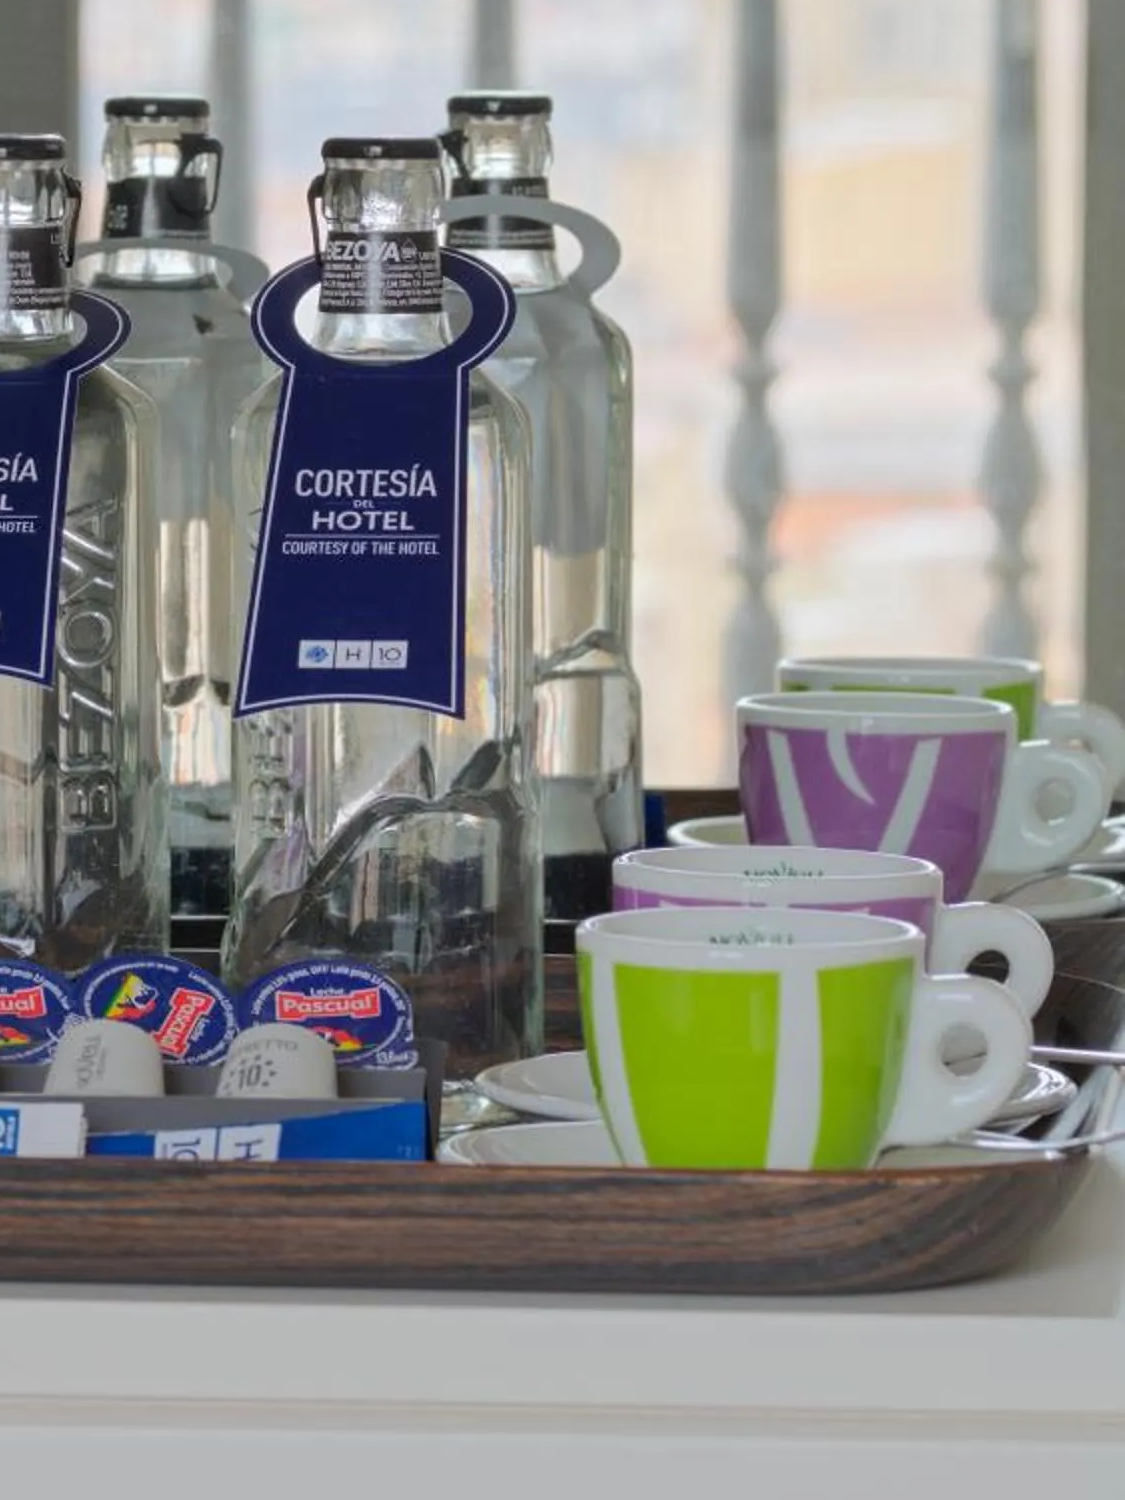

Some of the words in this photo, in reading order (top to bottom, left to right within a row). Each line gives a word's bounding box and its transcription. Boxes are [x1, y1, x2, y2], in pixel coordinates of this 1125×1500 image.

[295, 463, 438, 497] CORTESÍA
[353, 500, 374, 509] DEL
[311, 511, 415, 531] HOTEL
[282, 541, 349, 555] COURTESY
[351, 541, 366, 555] OF
[372, 541, 395, 555] THE
[398, 541, 440, 555] HOTEL
[346, 647, 361, 662] H
[378, 647, 402, 662] 10
[282, 994, 373, 1014] Pascual
